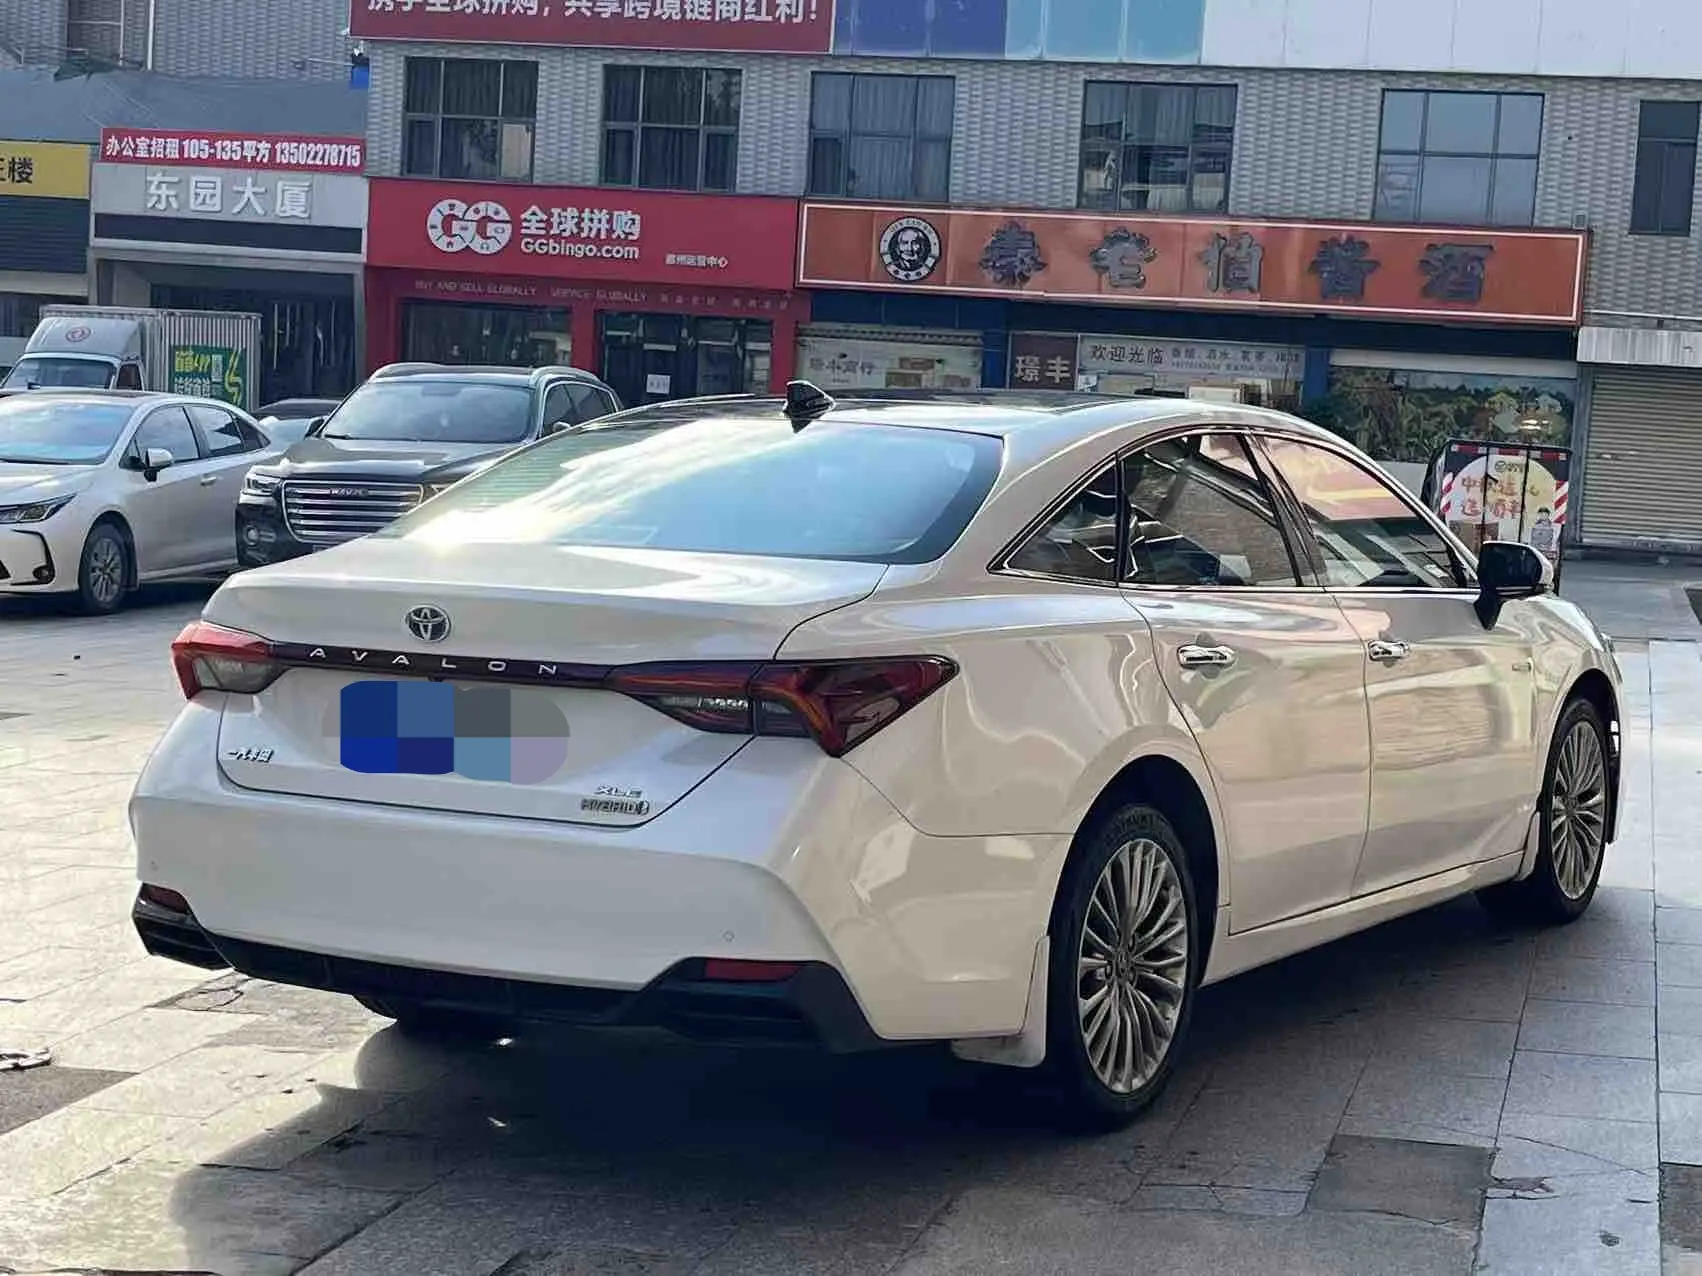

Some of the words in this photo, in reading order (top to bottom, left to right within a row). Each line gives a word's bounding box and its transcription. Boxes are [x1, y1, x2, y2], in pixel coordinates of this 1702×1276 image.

[106, 135, 179, 159] 办公室招租
[146, 172, 311, 219] 东园大厦
[520, 205, 641, 240] 全球拼购
[520, 238, 640, 260] GGbingo.com
[1091, 343, 1164, 365] 欢迎光临
[309, 647, 558, 676] AVALON
[594, 784, 643, 798] XLE
